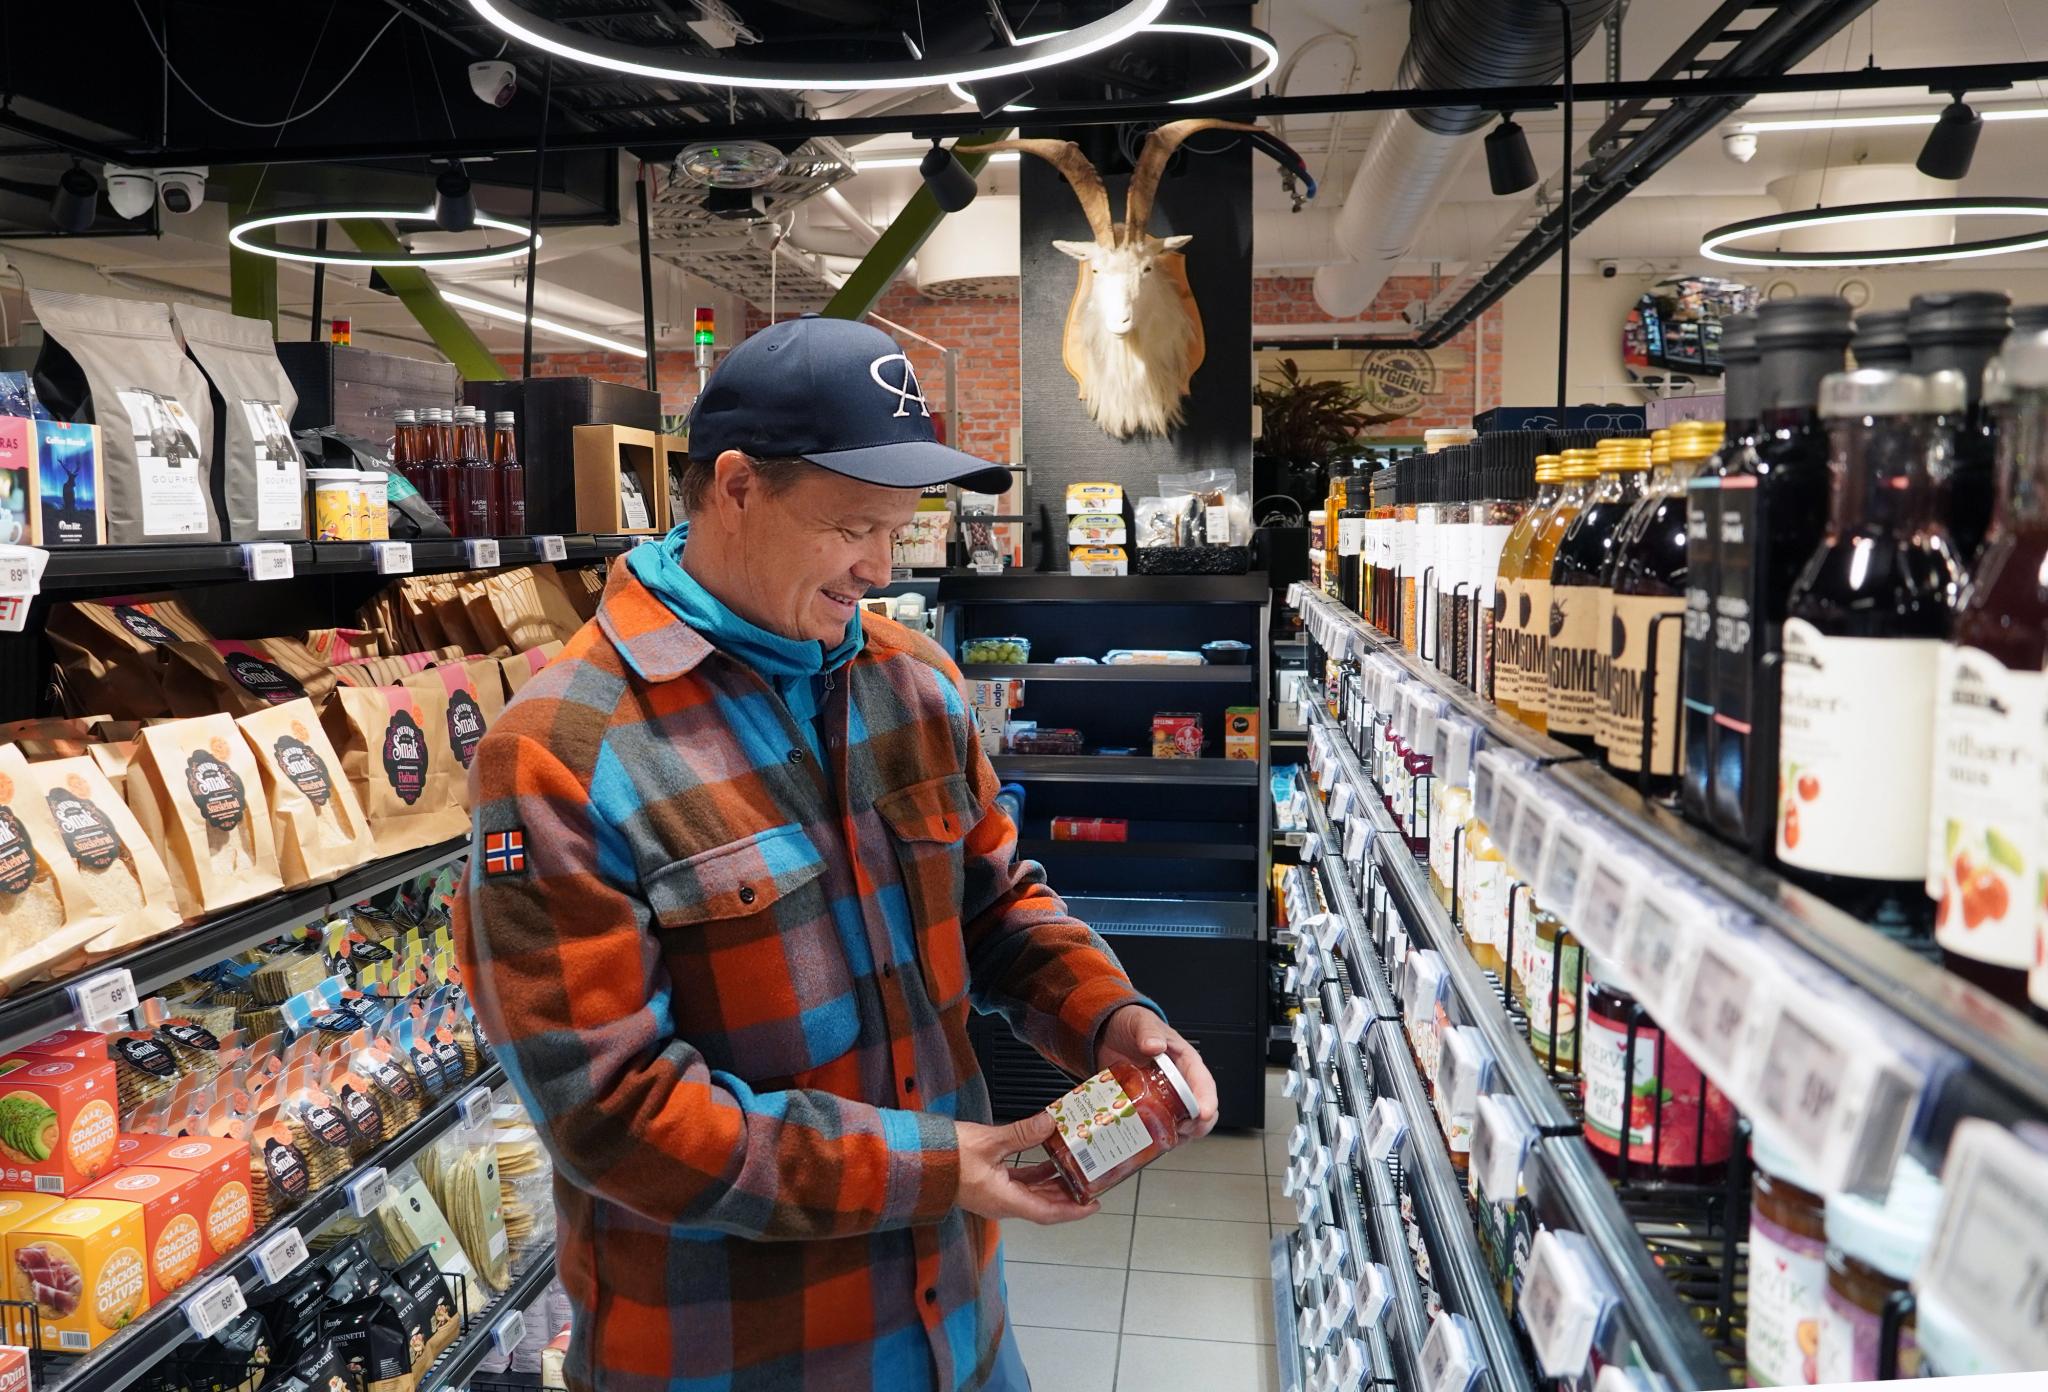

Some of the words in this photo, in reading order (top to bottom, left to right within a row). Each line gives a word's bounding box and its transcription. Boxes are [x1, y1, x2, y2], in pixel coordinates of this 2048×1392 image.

[1367, 362, 1429, 396] HYGIENE
[236, 667, 283, 685] Smak
[993, 682, 1005, 708] alpro
[453, 712, 480, 738] Smak
[392, 734, 419, 761] Smak
[282, 754, 316, 776] Smak
[195, 771, 231, 796] Smak
[56, 808, 101, 834] Smak
[127, 1041, 159, 1060] Smak
[308, 1108, 336, 1130] Smak
[347, 1096, 372, 1119] Smak
[70, 1115, 114, 1145] CRACKER
[72, 1126, 116, 1158] TOMATO
[271, 1151, 297, 1176] Smak
[208, 1195, 250, 1226] CRACKER
[210, 1207, 249, 1238] TOMATO
[155, 1228, 201, 1261] CRACKER
[158, 1240, 201, 1275] TOMATO
[96, 1261, 143, 1298] CRACKER
[98, 1274, 143, 1313] OLIVES
